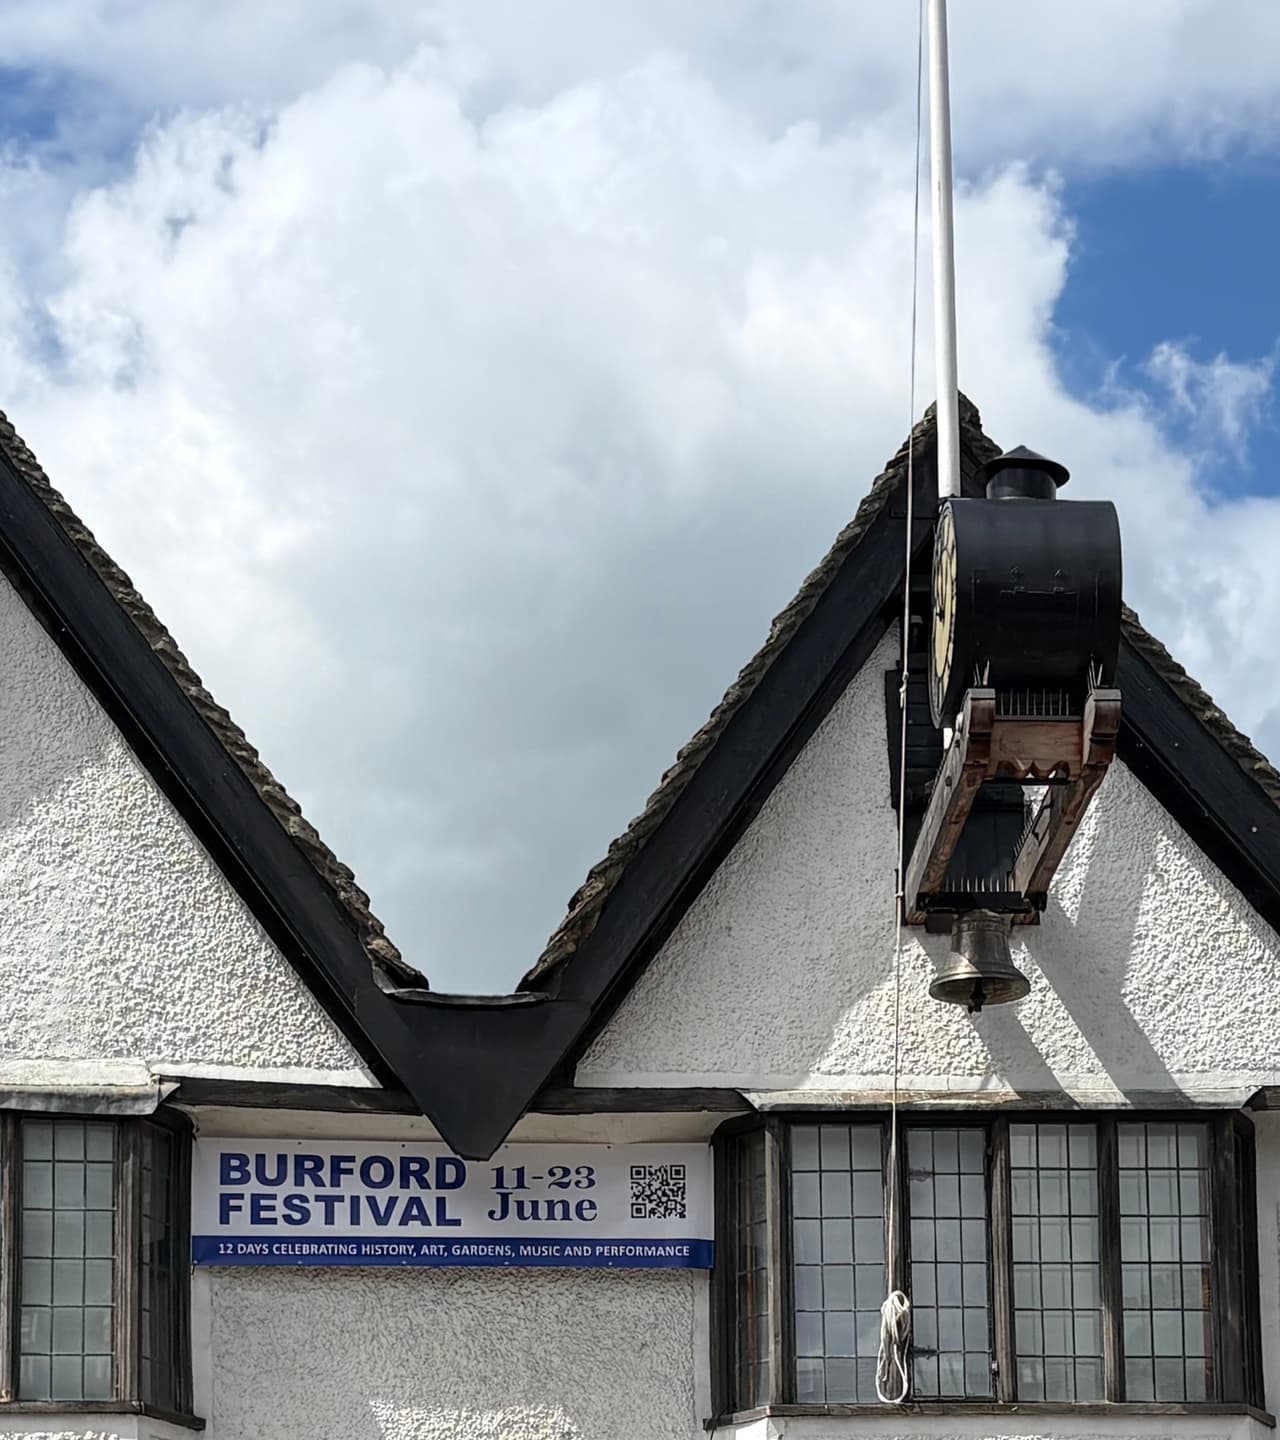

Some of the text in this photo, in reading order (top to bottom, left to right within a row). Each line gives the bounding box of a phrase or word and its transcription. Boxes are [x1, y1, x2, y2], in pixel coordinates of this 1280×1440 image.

[219, 1152, 467, 1191] BURFORD
[489, 1165, 597, 1190] 11-23
[219, 1192, 462, 1227] FESTIVAL
[487, 1191, 598, 1222] June
[218, 1243, 690, 1258] 12 DAYS CELEBRATING HISTORY, ART, GARDENS, MUSIC AND PERFORMANCE
